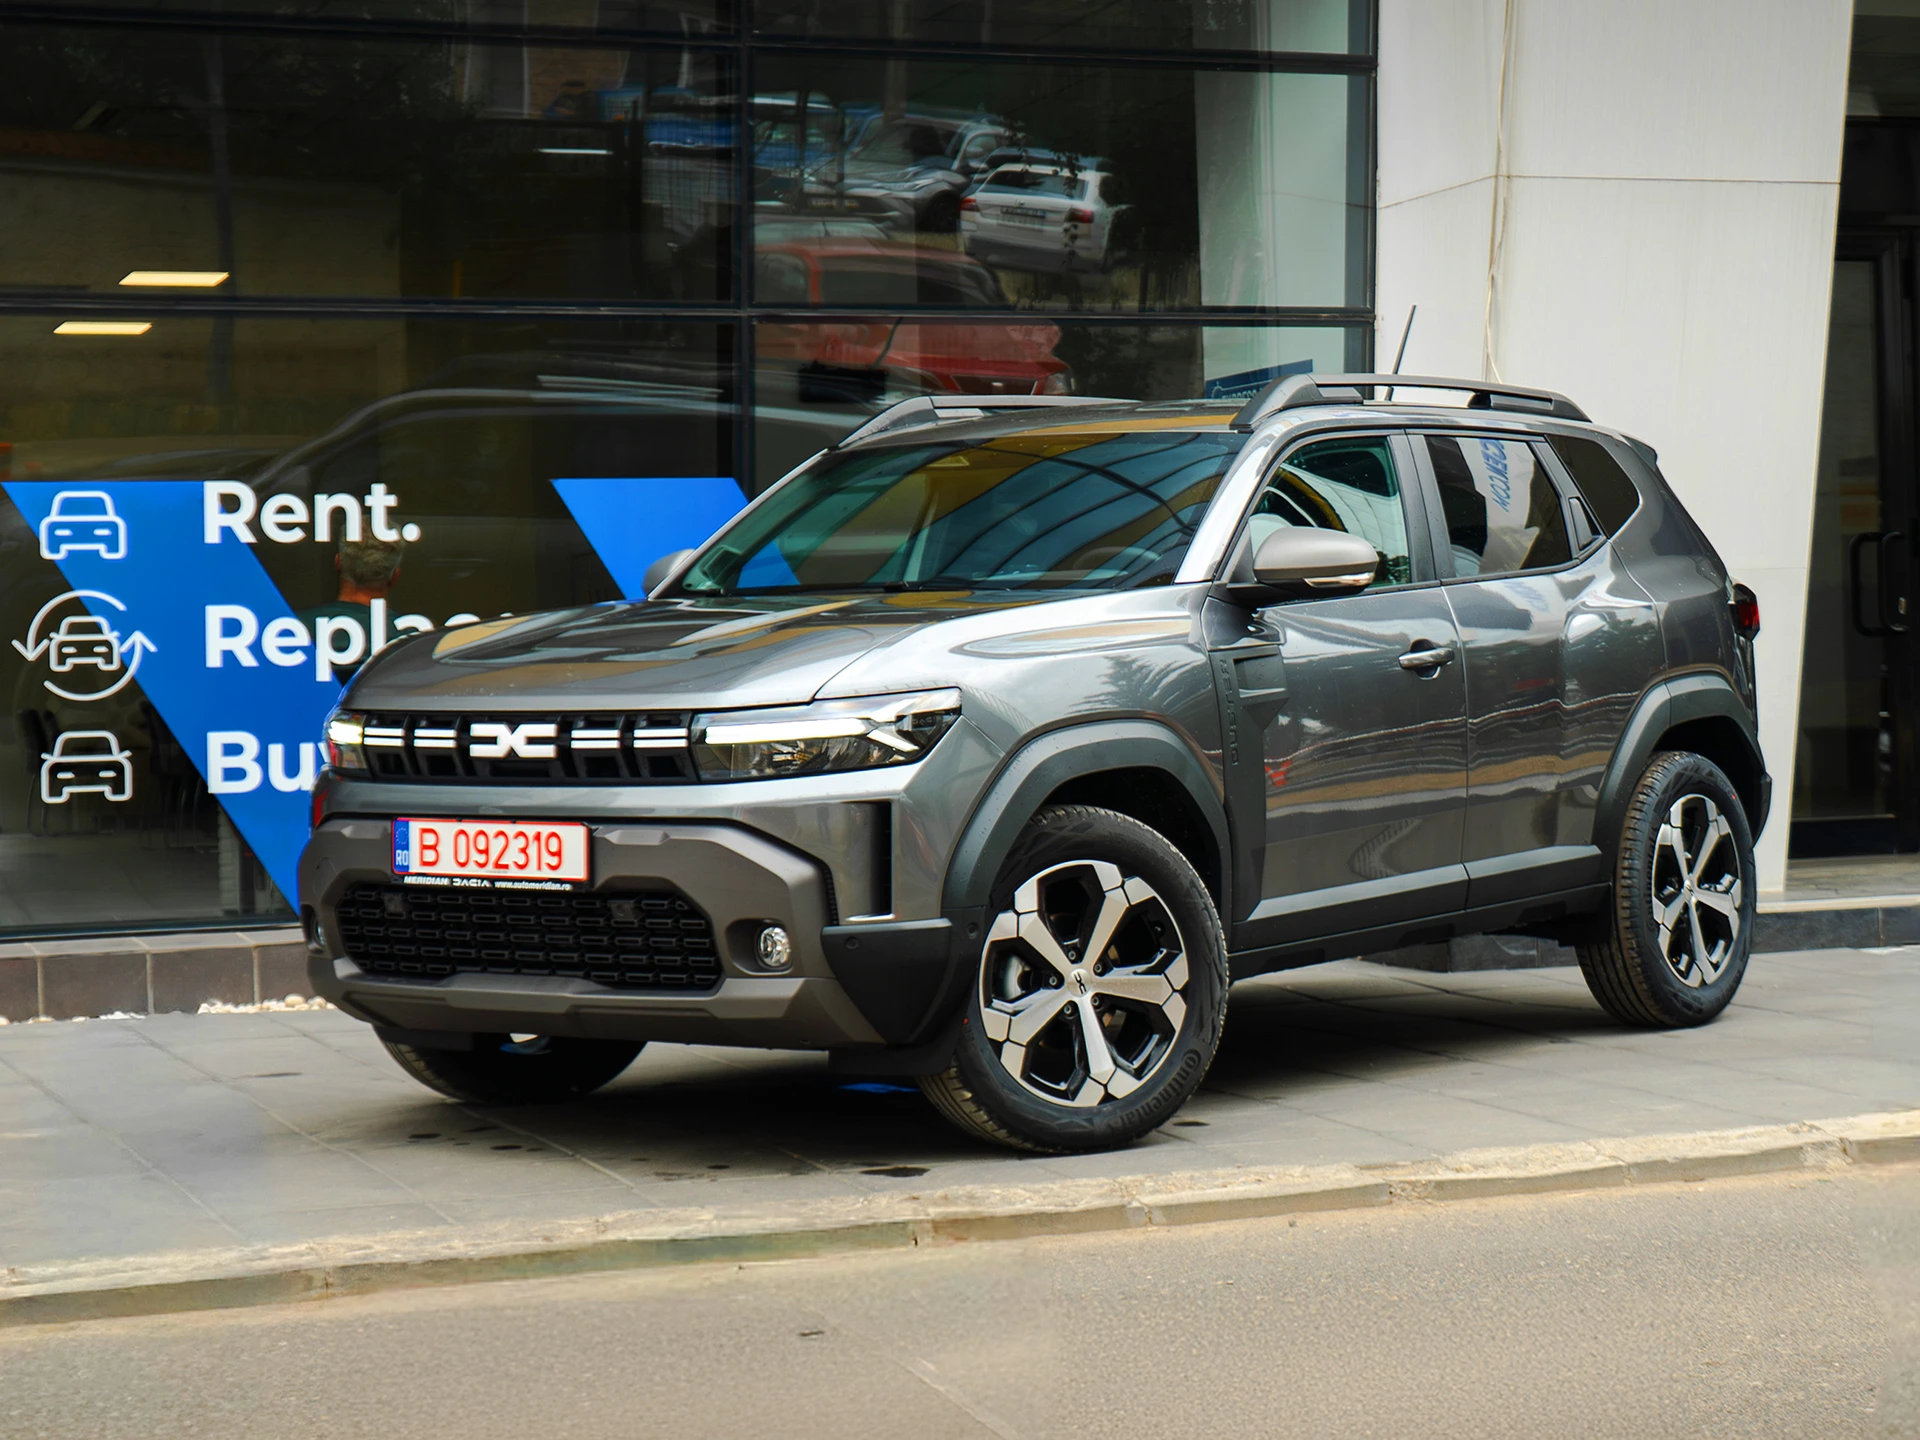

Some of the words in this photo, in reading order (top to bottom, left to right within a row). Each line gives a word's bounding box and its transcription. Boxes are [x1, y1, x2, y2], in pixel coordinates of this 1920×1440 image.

[203, 481, 421, 544] Rent.
[205, 598, 514, 682] Repl
[206, 731, 330, 794] Bu
[395, 850, 408, 866] RO
[418, 827, 439, 867] B
[453, 828, 563, 871] 092319
[404, 875, 449, 886] MERIDIAN
[452, 878, 490, 887] DACIA
